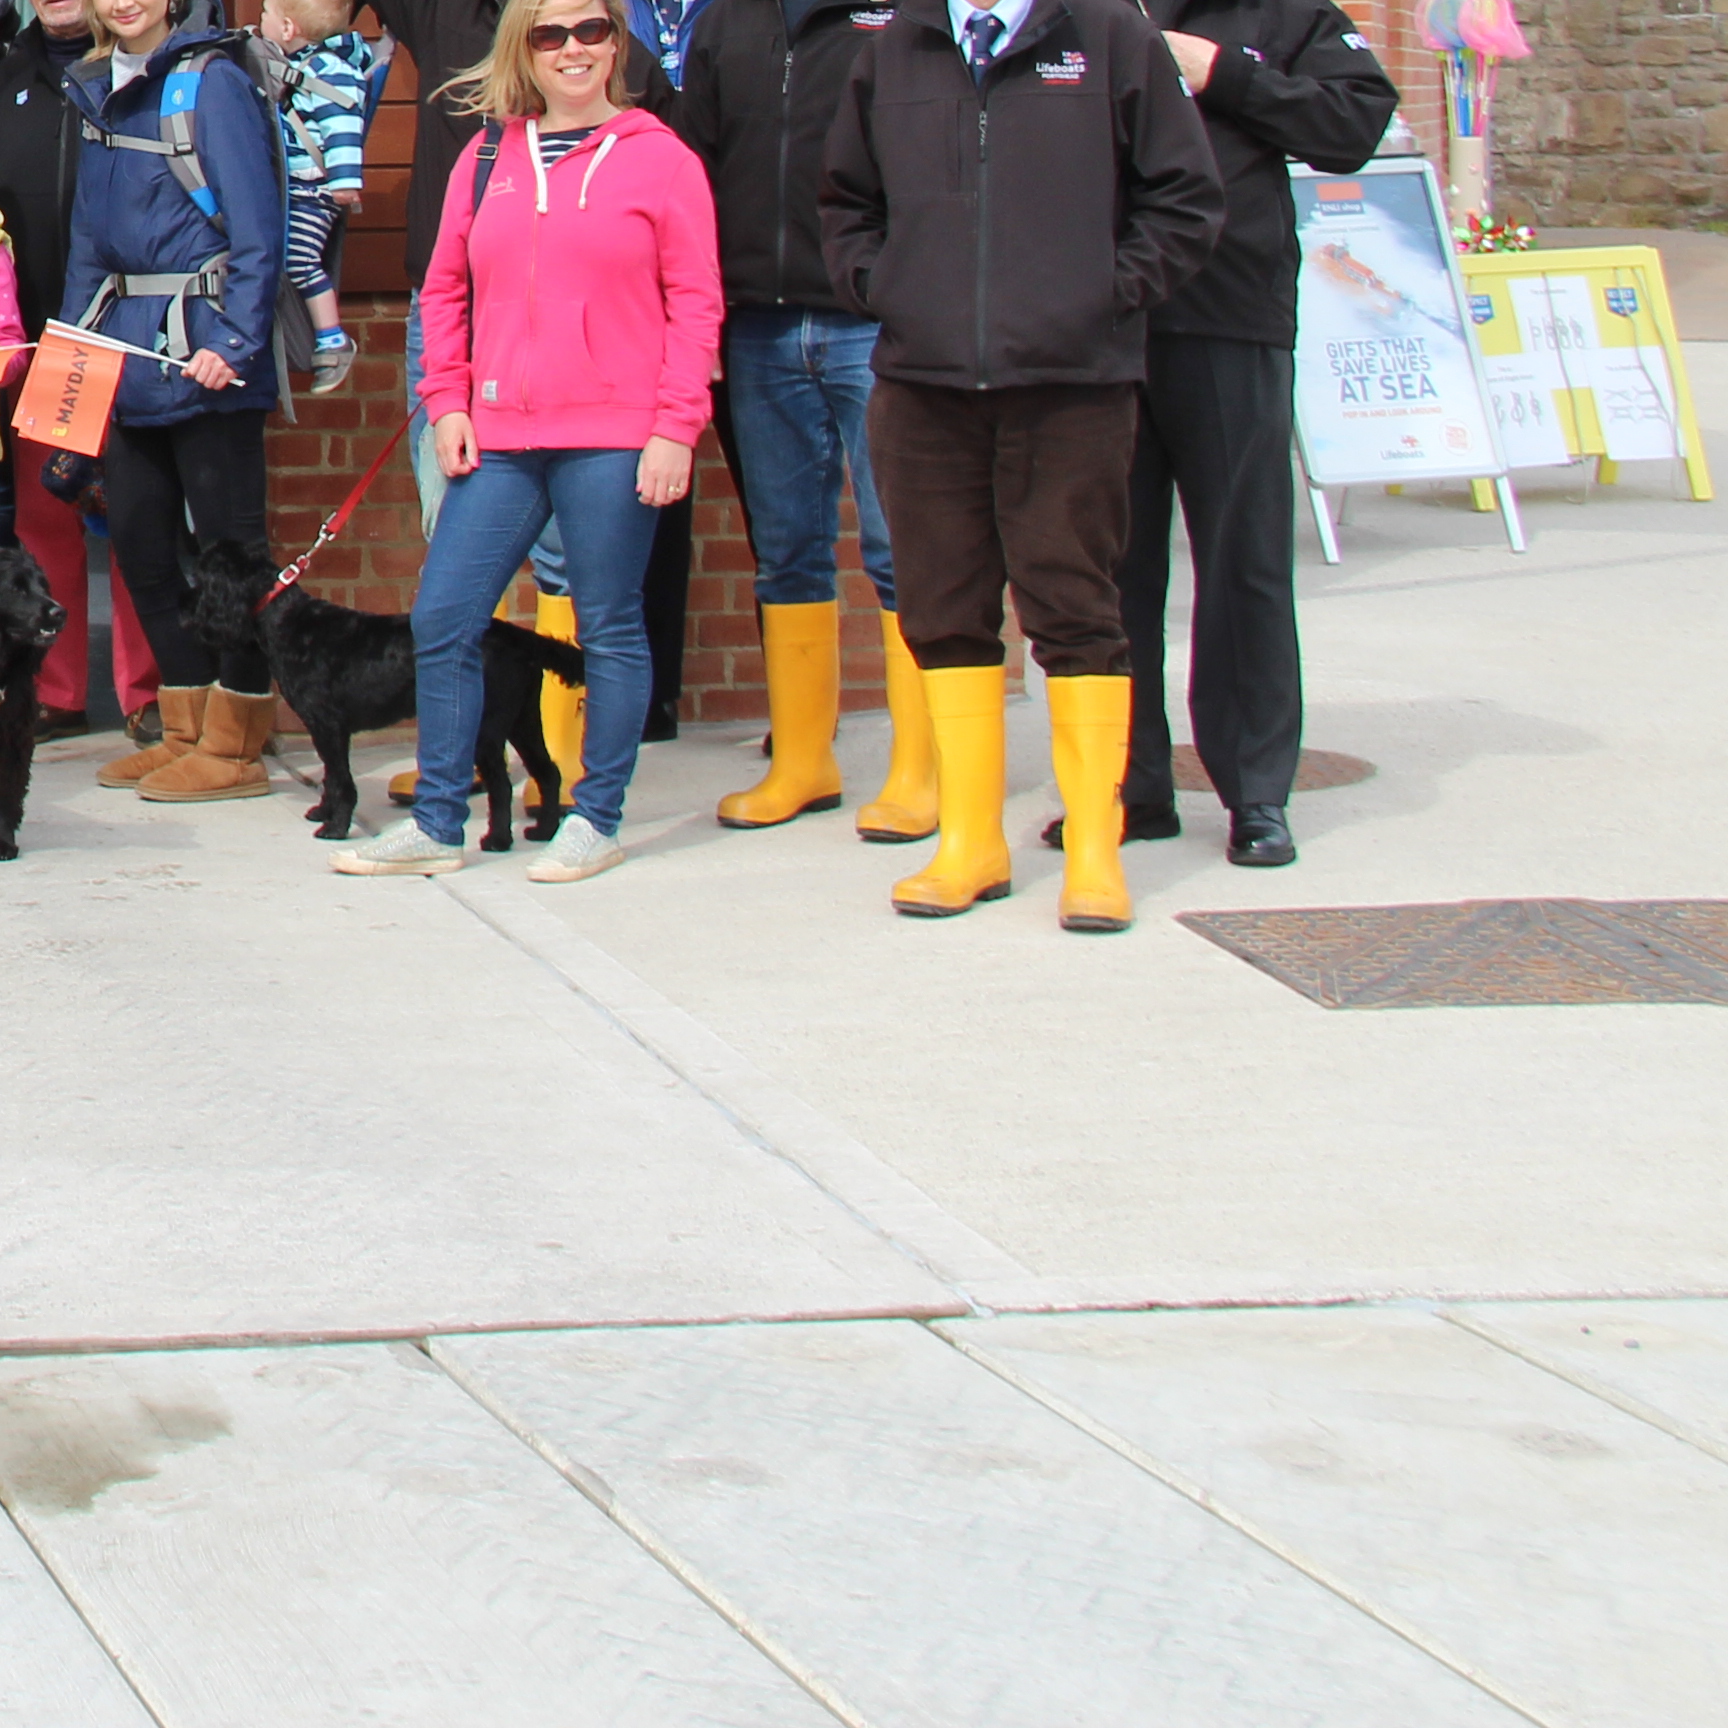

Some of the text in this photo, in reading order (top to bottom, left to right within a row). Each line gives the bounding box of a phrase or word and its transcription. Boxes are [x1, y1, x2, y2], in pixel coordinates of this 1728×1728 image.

[1035, 62, 1085, 73] Lifeboats
[1326, 337, 1426, 359] GIFTS THAT
[1330, 354, 1432, 376] SAVE LIVES
[56, 346, 90, 424] MAYDAY
[1339, 373, 1439, 403] AT SEA
[1380, 447, 1426, 461] Lifeboats
